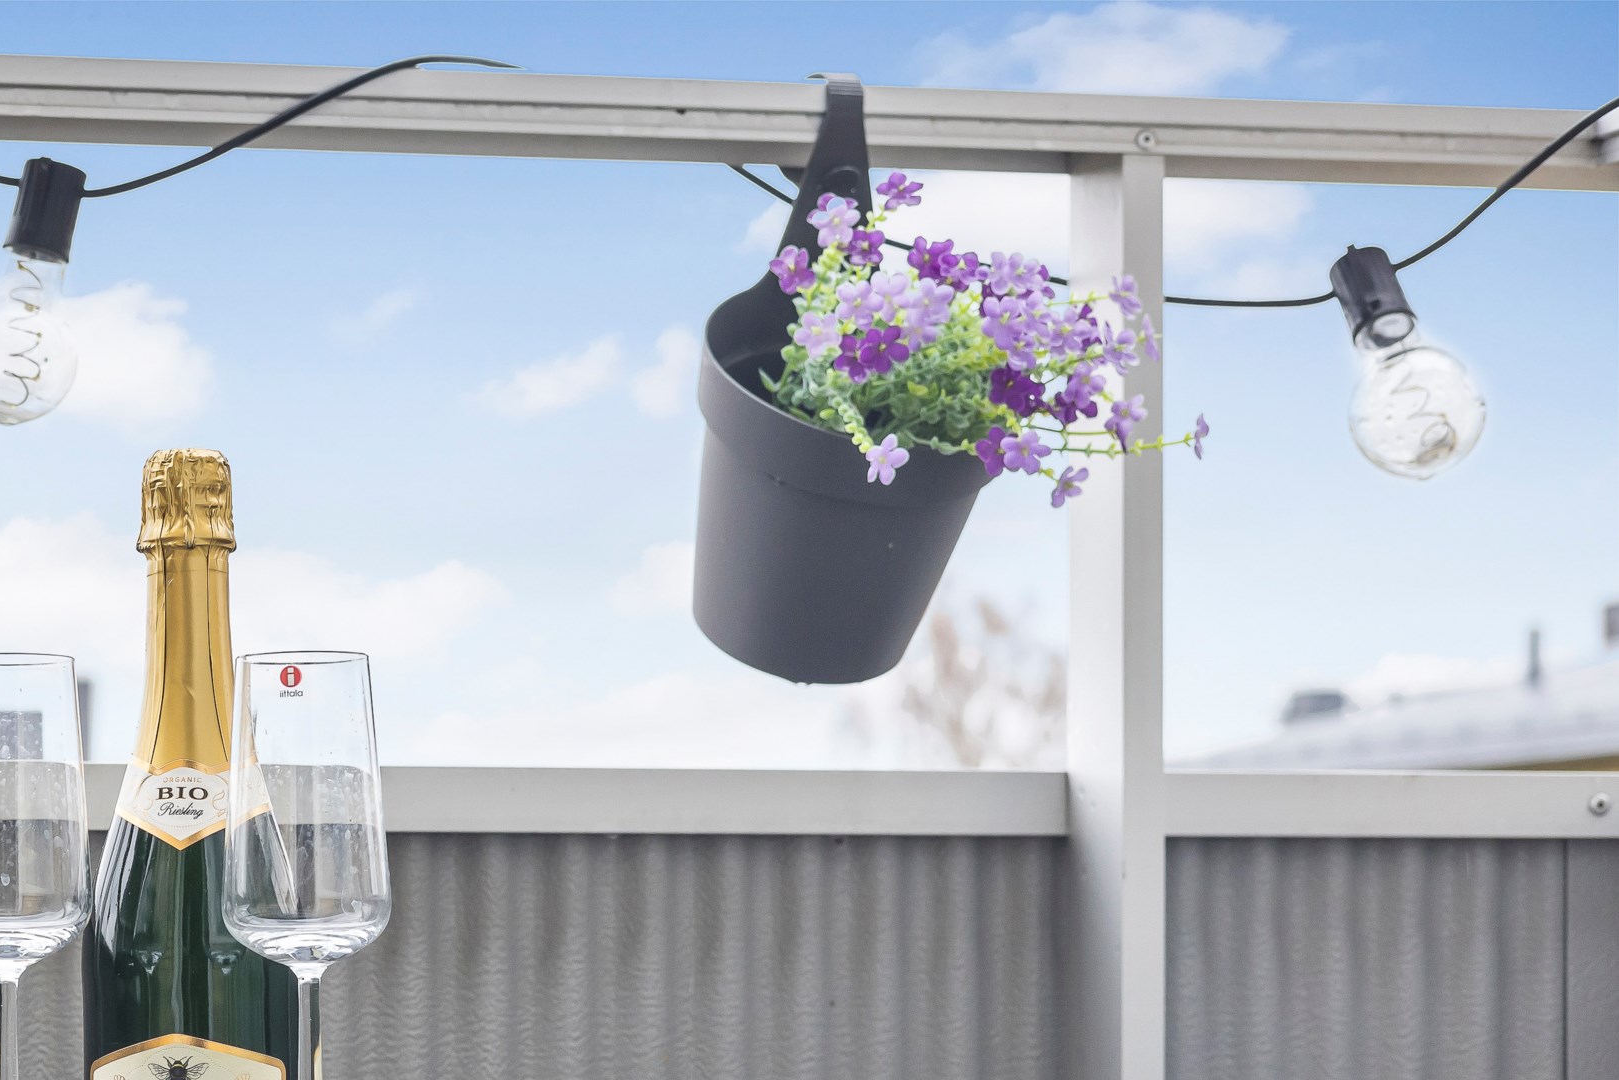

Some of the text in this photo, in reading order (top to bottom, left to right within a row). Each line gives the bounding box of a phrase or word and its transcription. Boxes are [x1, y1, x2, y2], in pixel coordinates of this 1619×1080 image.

[279, 689, 304, 698] iittala
[155, 786, 209, 801] BIO
[157, 801, 204, 820] Riesling
